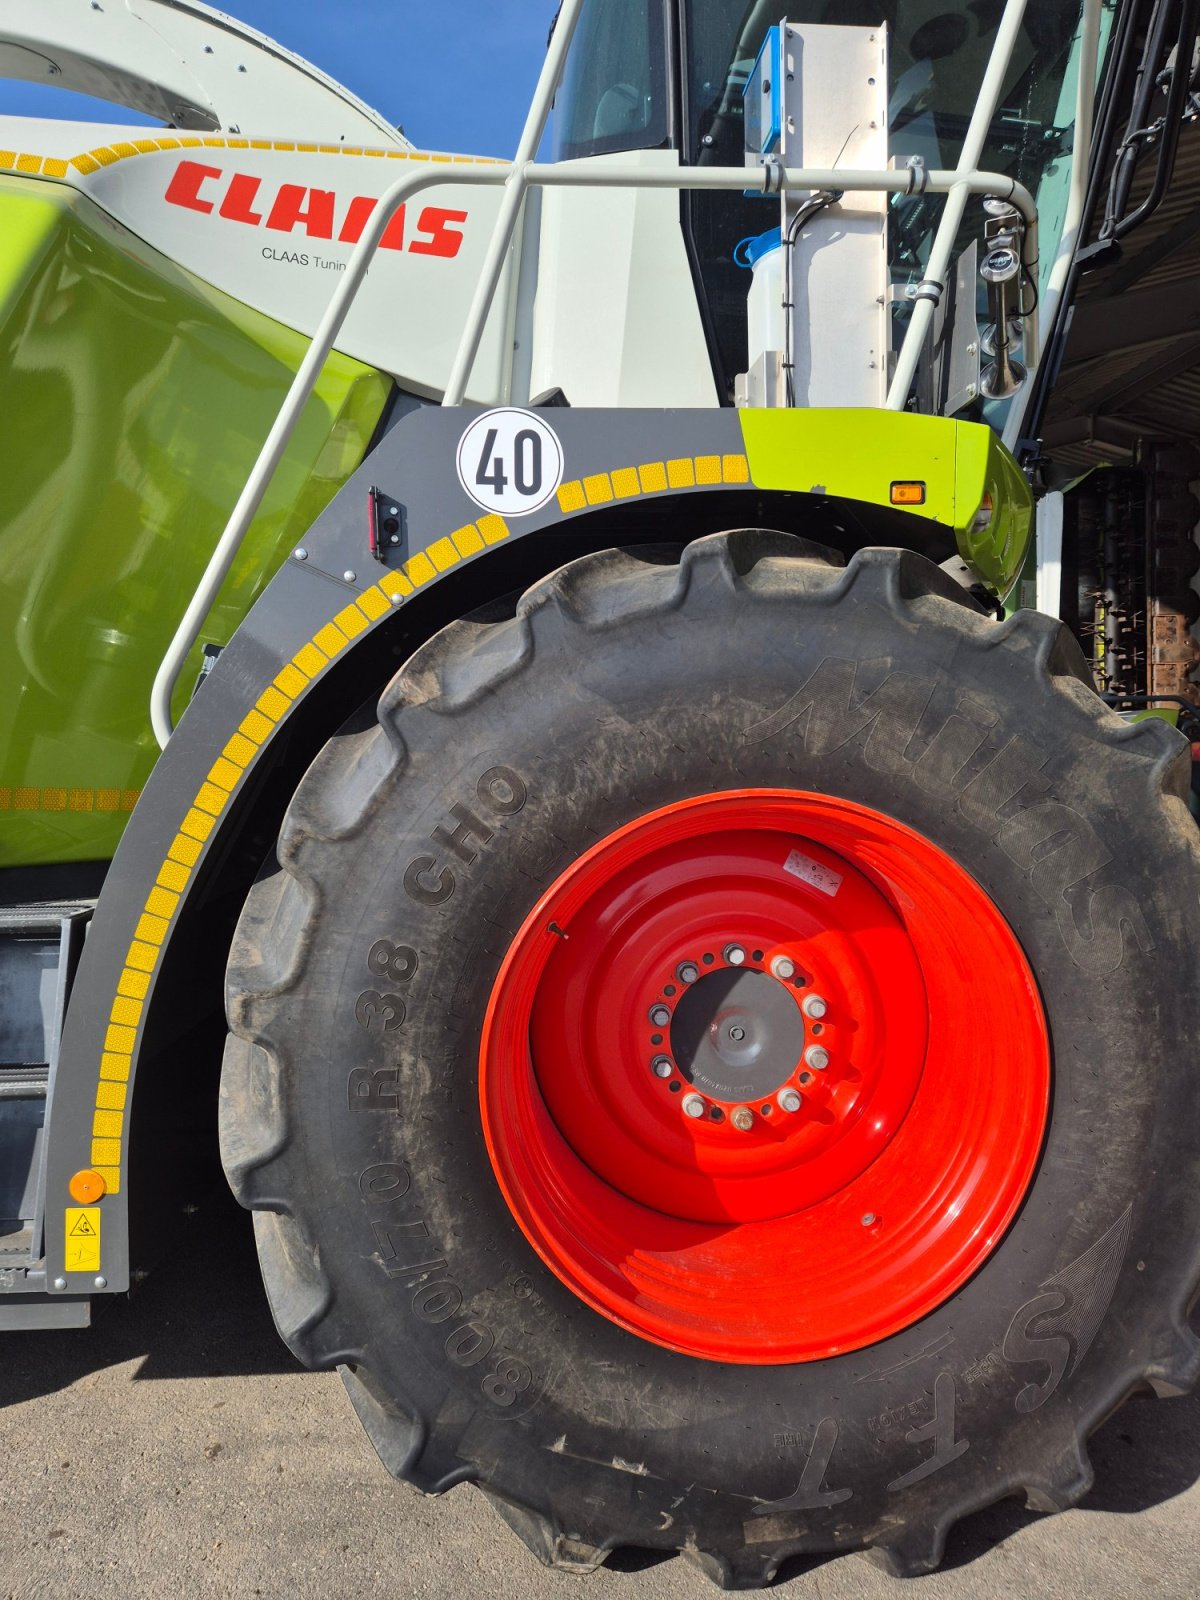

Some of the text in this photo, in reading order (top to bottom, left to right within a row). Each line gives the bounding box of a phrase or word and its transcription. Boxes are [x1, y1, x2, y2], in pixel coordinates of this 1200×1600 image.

[164, 160, 469, 259] CLAAS
[261, 247, 348, 271] CLAAS Tunin
[475, 428, 542, 496] 40
[346, 764, 533, 1406] 800/70 R 38 CHO
